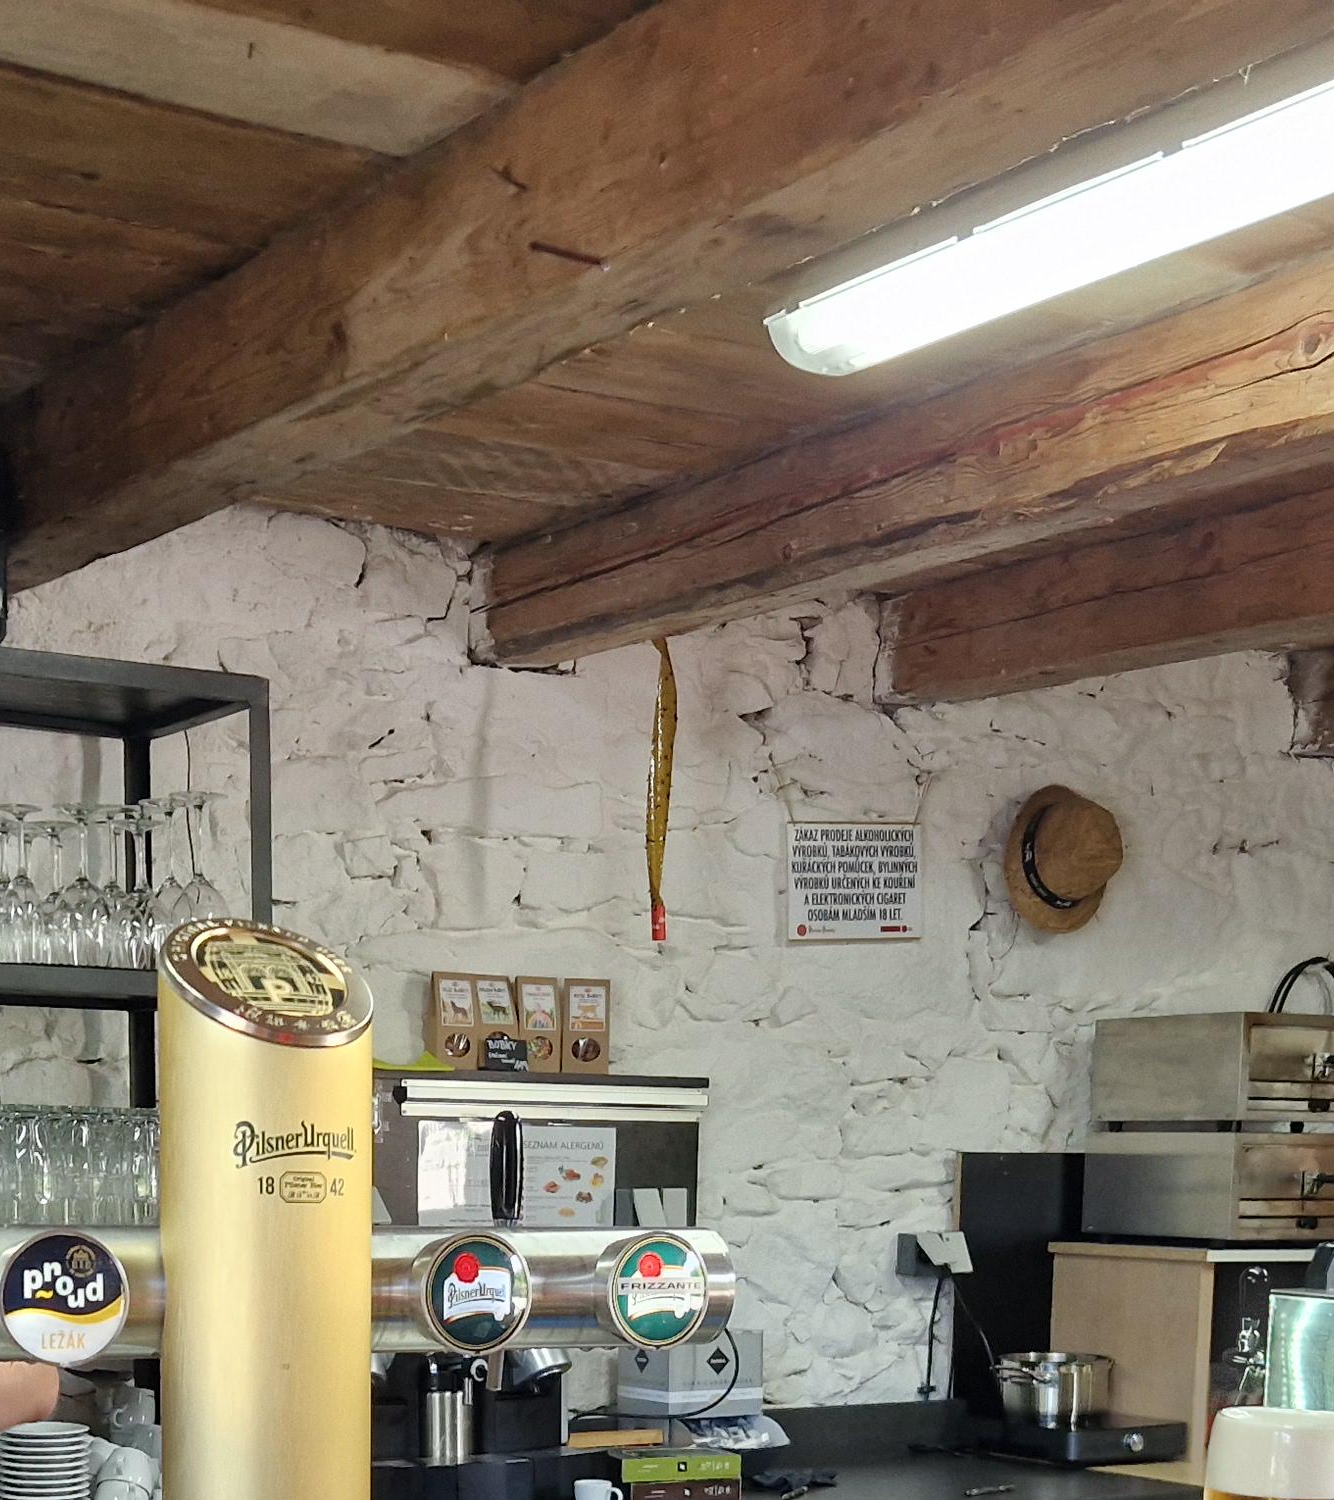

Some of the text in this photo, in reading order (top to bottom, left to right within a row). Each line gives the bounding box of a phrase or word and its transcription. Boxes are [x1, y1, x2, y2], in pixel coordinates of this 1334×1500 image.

[794, 827, 914, 842] ZÁKAZ PRODEJE ALKOHOLICKÝCH
[831, 842, 879, 857] TABÁKOVÝCH
[791, 858, 836, 873] KUŘÁCKÝCH
[878, 858, 918, 873] BYLINNÝCH
[794, 874, 916, 889] VÝROBKŮ URČENÝCH KE KOUŘENÍ
[804, 890, 907, 906] A ELEKTRONICKÝCH CIGARET
[807, 906, 840, 921] OSOBÁM
[841, 906, 877, 921] MLADŠÍM
[879, 908, 887, 920] 18
[233, 1120, 354, 1169] Pilsner Urquell
[523, 1141, 557, 1149] SEZNAM
[257, 1176, 275, 1195] 18
[330, 1178, 345, 1196] 42
[23, 1261, 104, 1309] proud
[620, 1281, 702, 1290] FRIZZANTE
[41, 1330, 86, 1350] LEŽÁK
